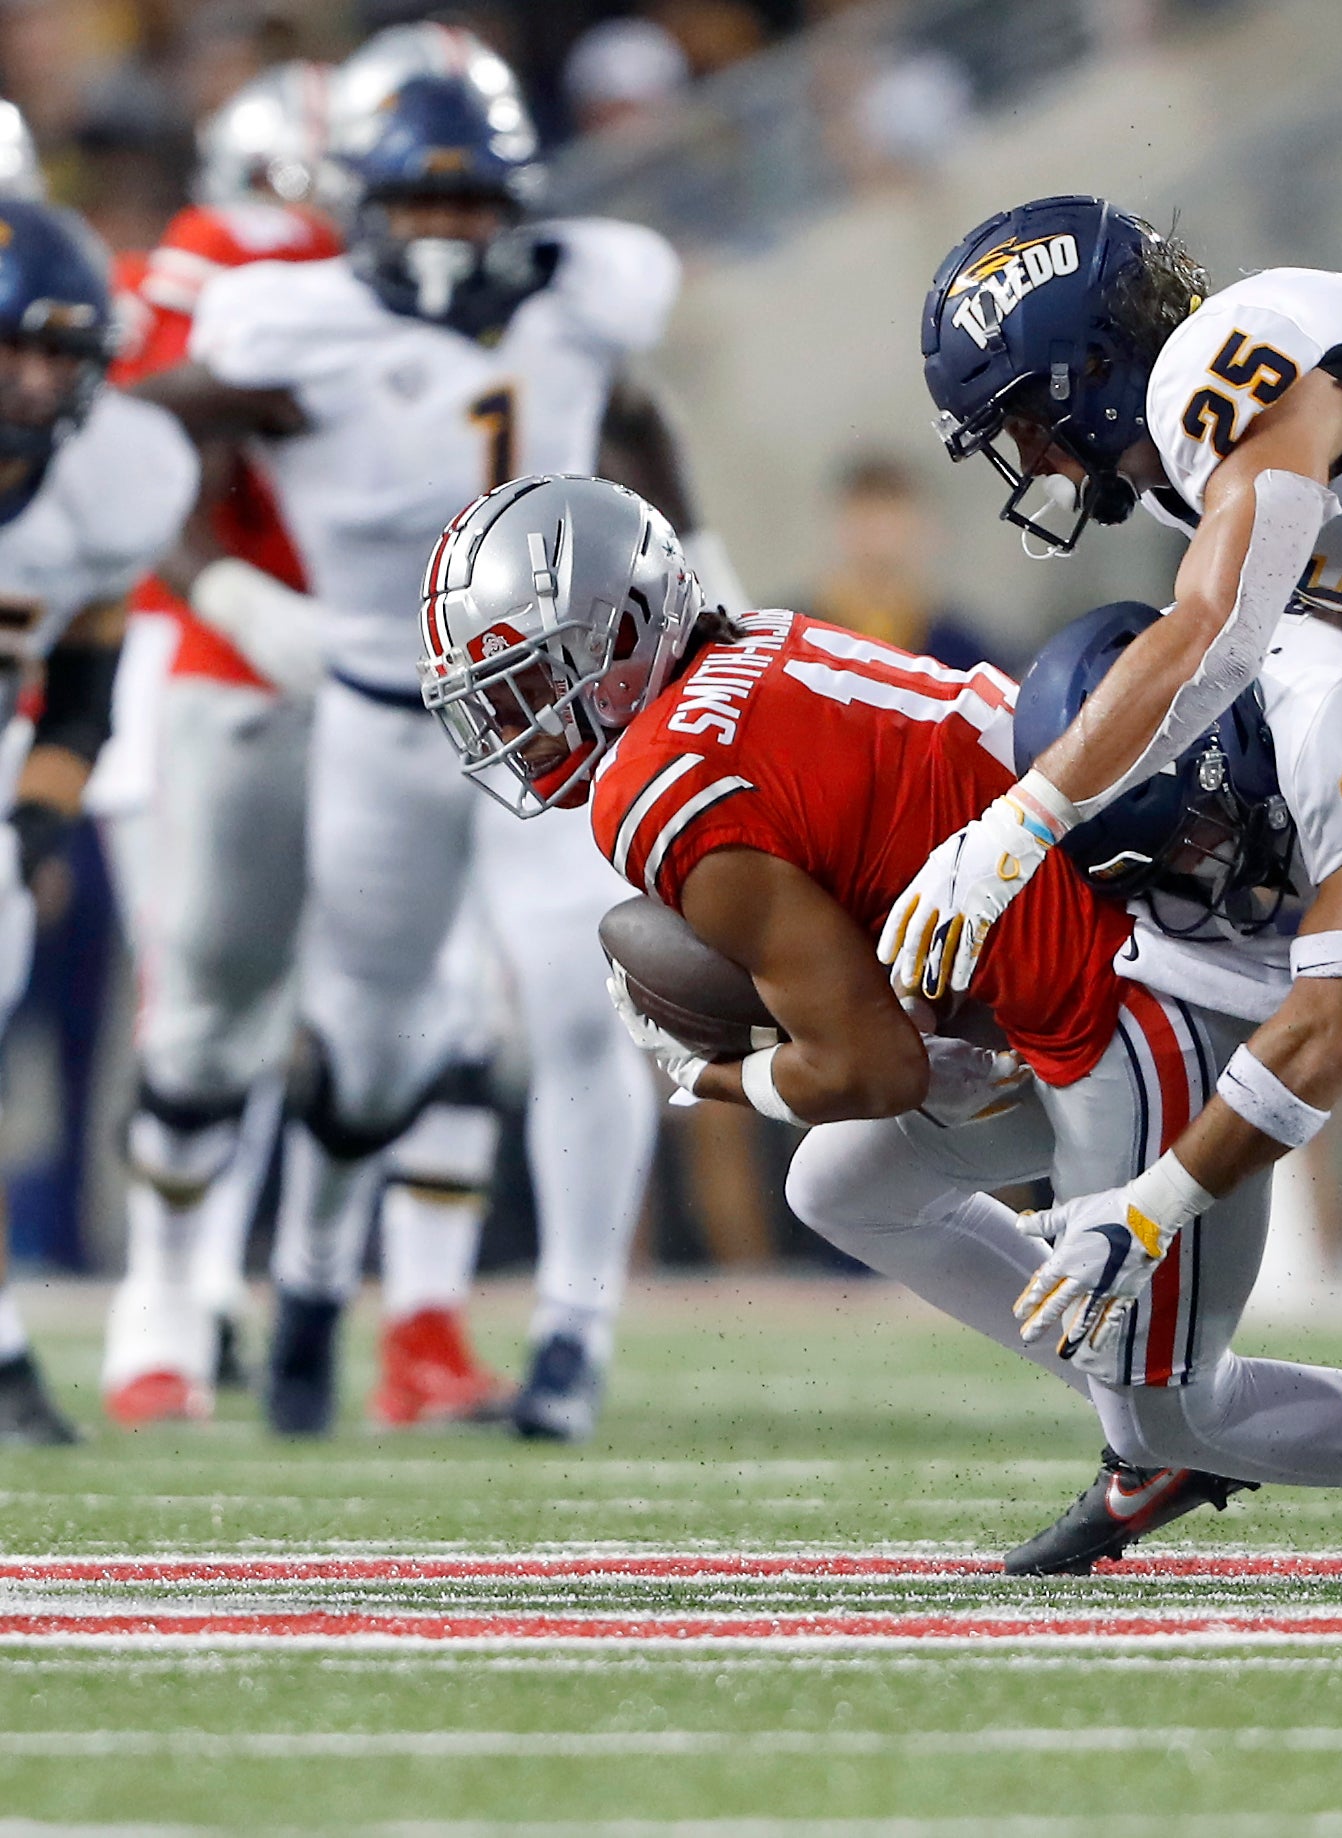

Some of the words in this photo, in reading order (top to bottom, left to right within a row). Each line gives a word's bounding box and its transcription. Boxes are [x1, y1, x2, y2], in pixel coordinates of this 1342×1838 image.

[951, 234, 1080, 351] TOLEDO
[1179, 327, 1302, 460] 25
[782, 626, 1021, 779] 11
